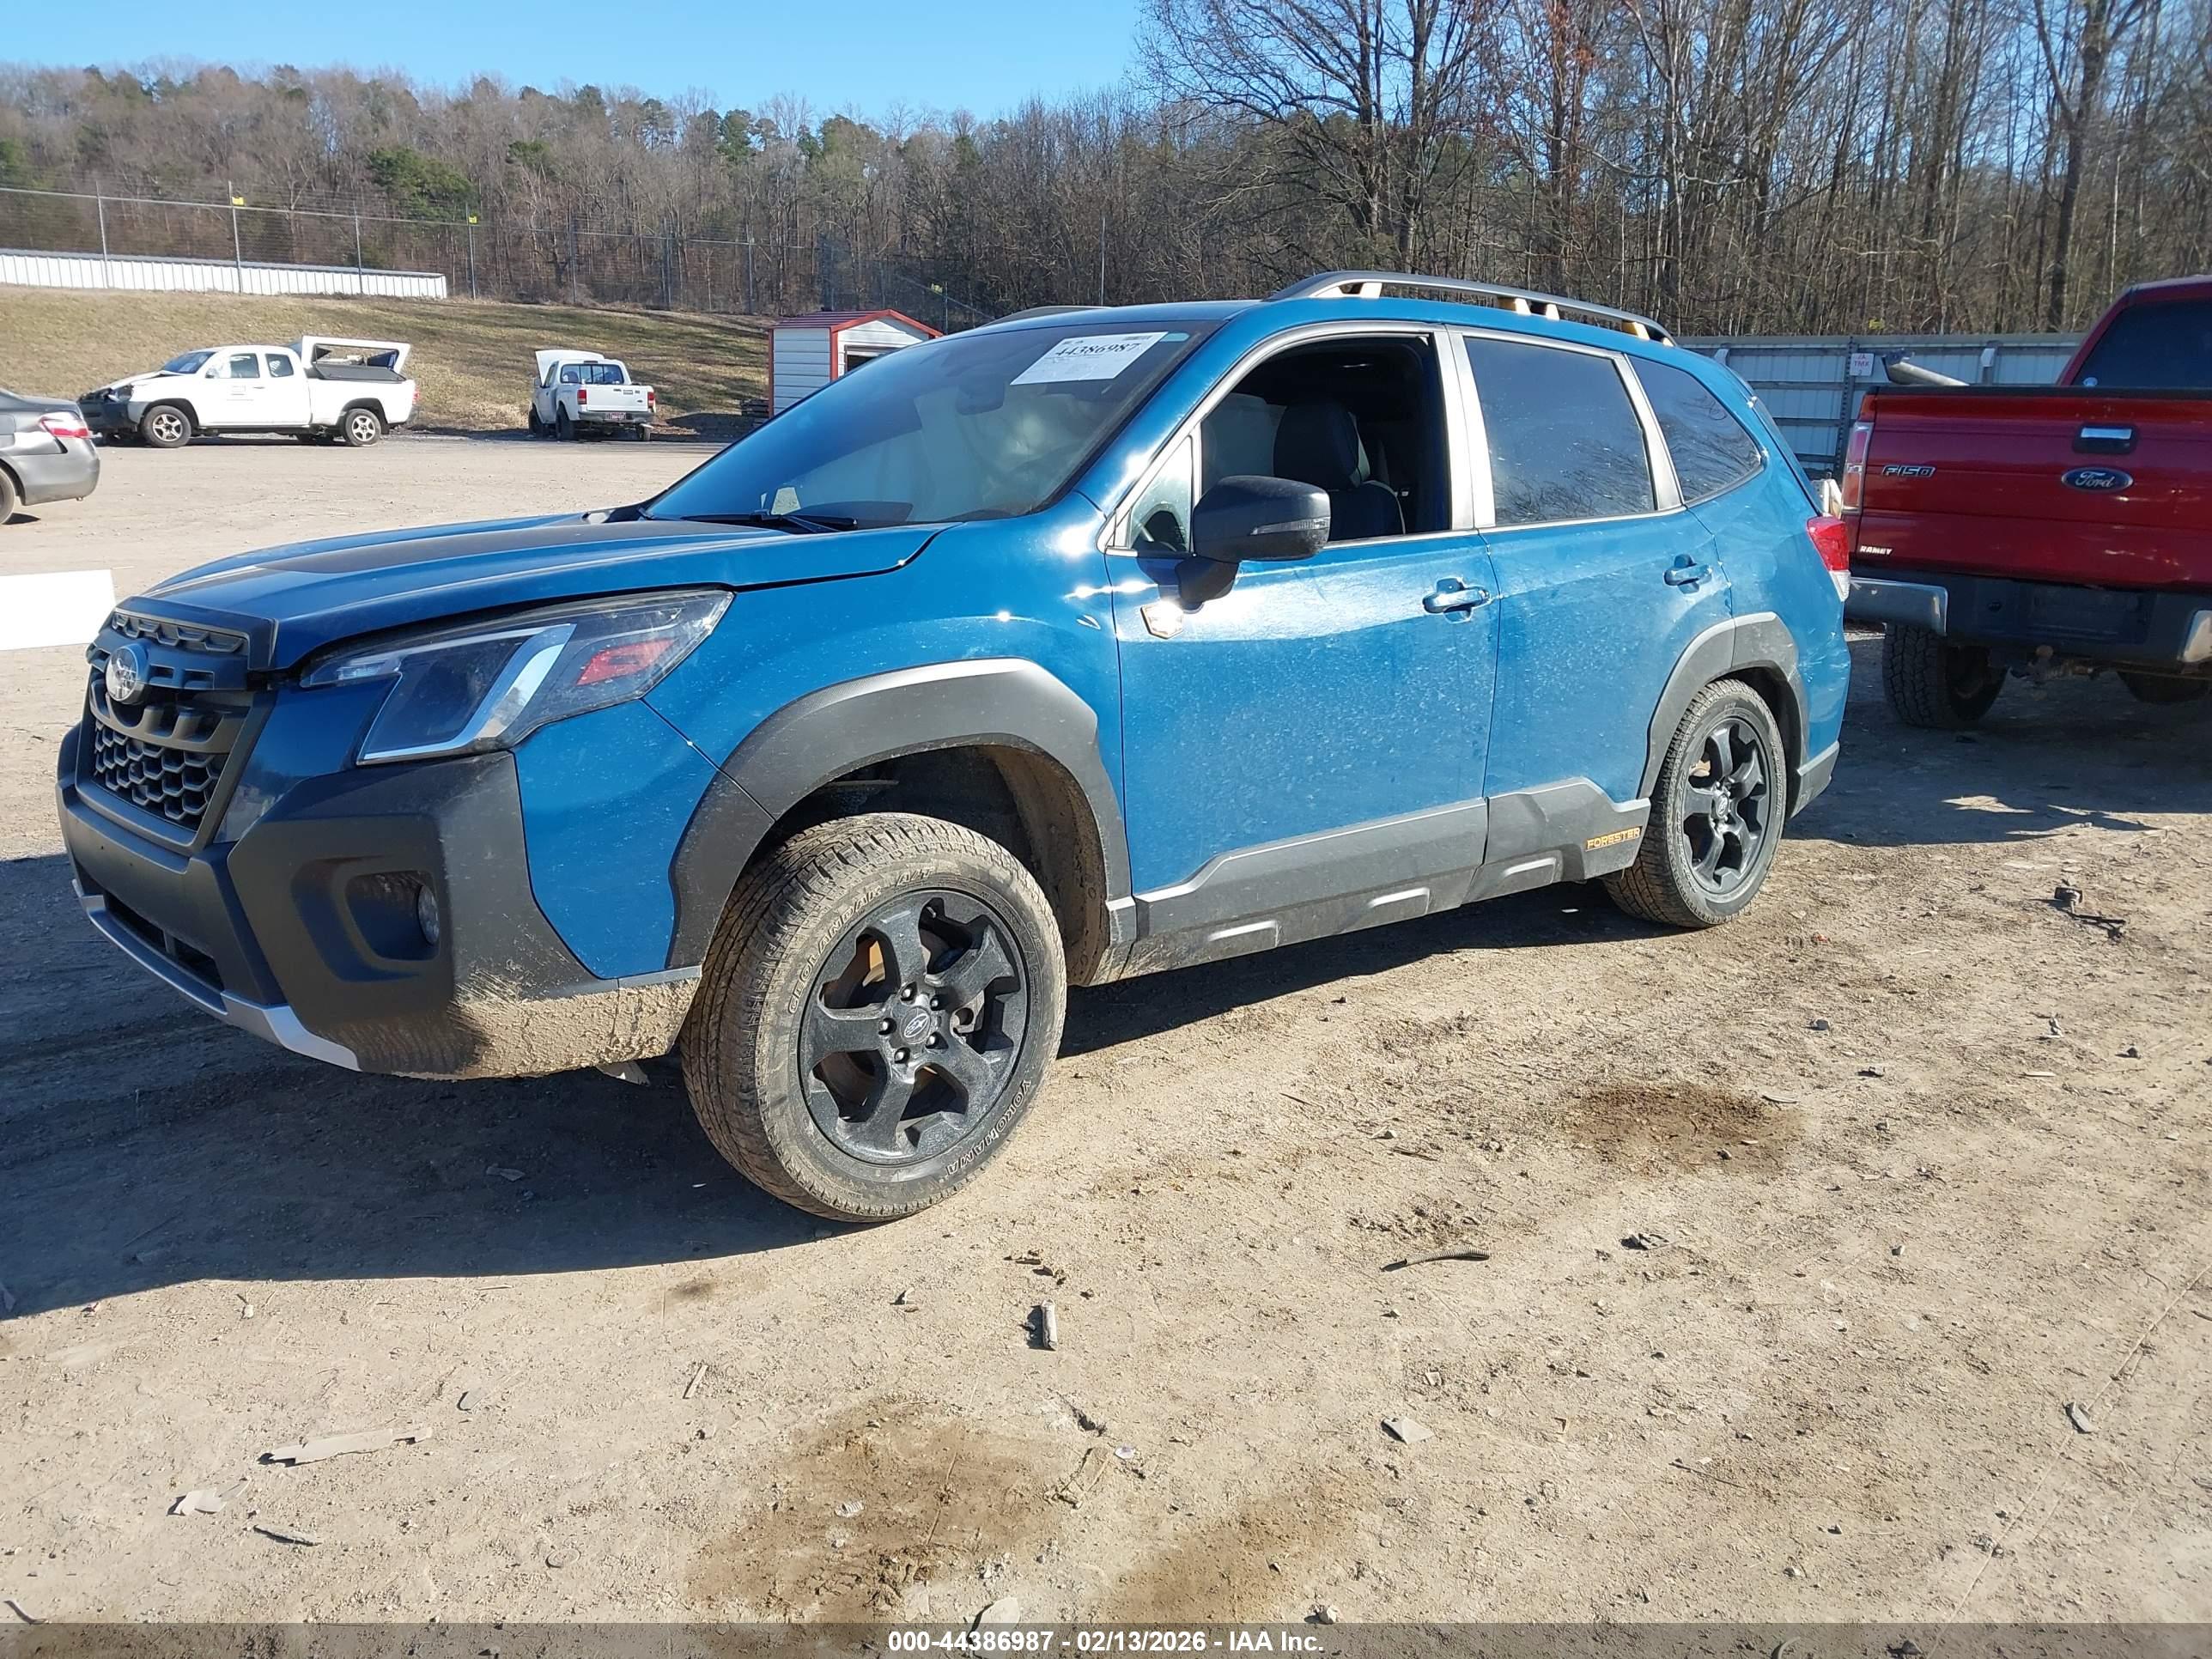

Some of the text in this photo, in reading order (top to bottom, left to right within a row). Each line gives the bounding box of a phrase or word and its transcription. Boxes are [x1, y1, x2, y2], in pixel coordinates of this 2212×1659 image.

[1055, 343, 1141, 356] 44386987
[2075, 471, 2116, 488] Ford
[1586, 827, 1641, 850] FORESTER
[945, 1079, 1032, 1176] YOKOHAMA
